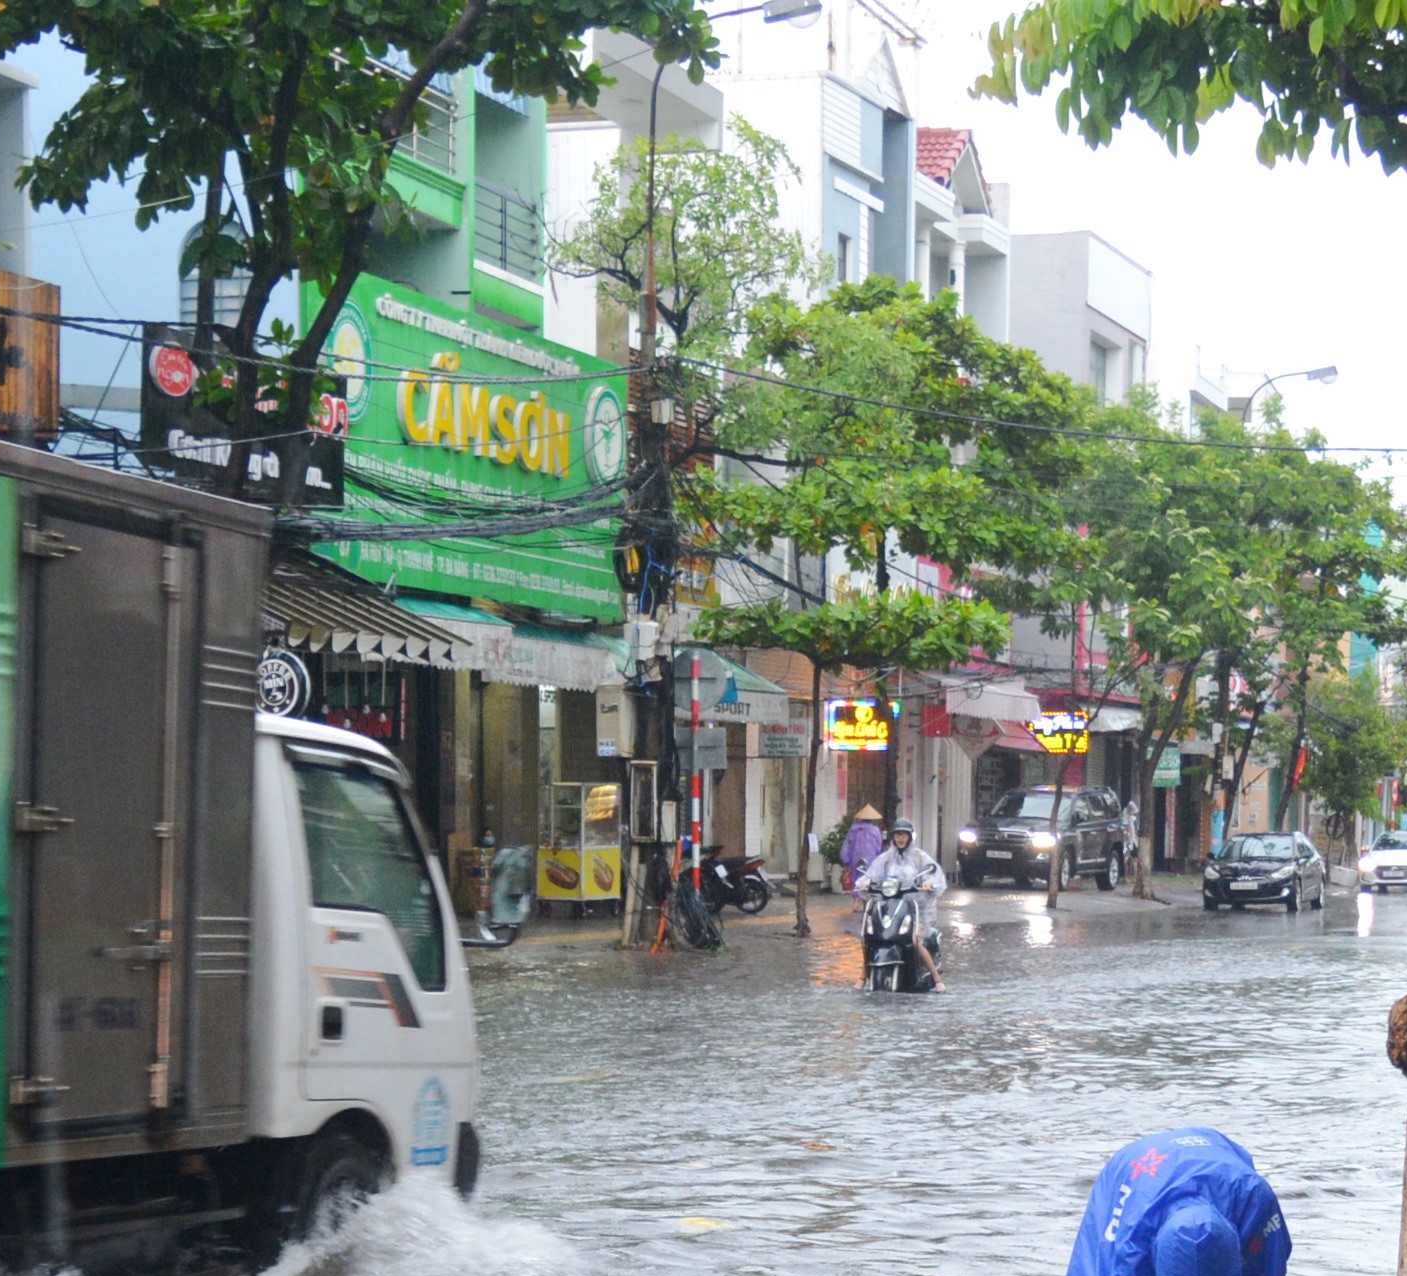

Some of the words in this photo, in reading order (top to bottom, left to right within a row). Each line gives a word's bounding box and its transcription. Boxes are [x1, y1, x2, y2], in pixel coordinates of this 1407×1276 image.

[397, 352, 490, 458] CẨM
[489, 390, 571, 479] SƠN
[257, 662, 294, 686] OFFEE
[714, 702, 752, 718] SPORT
